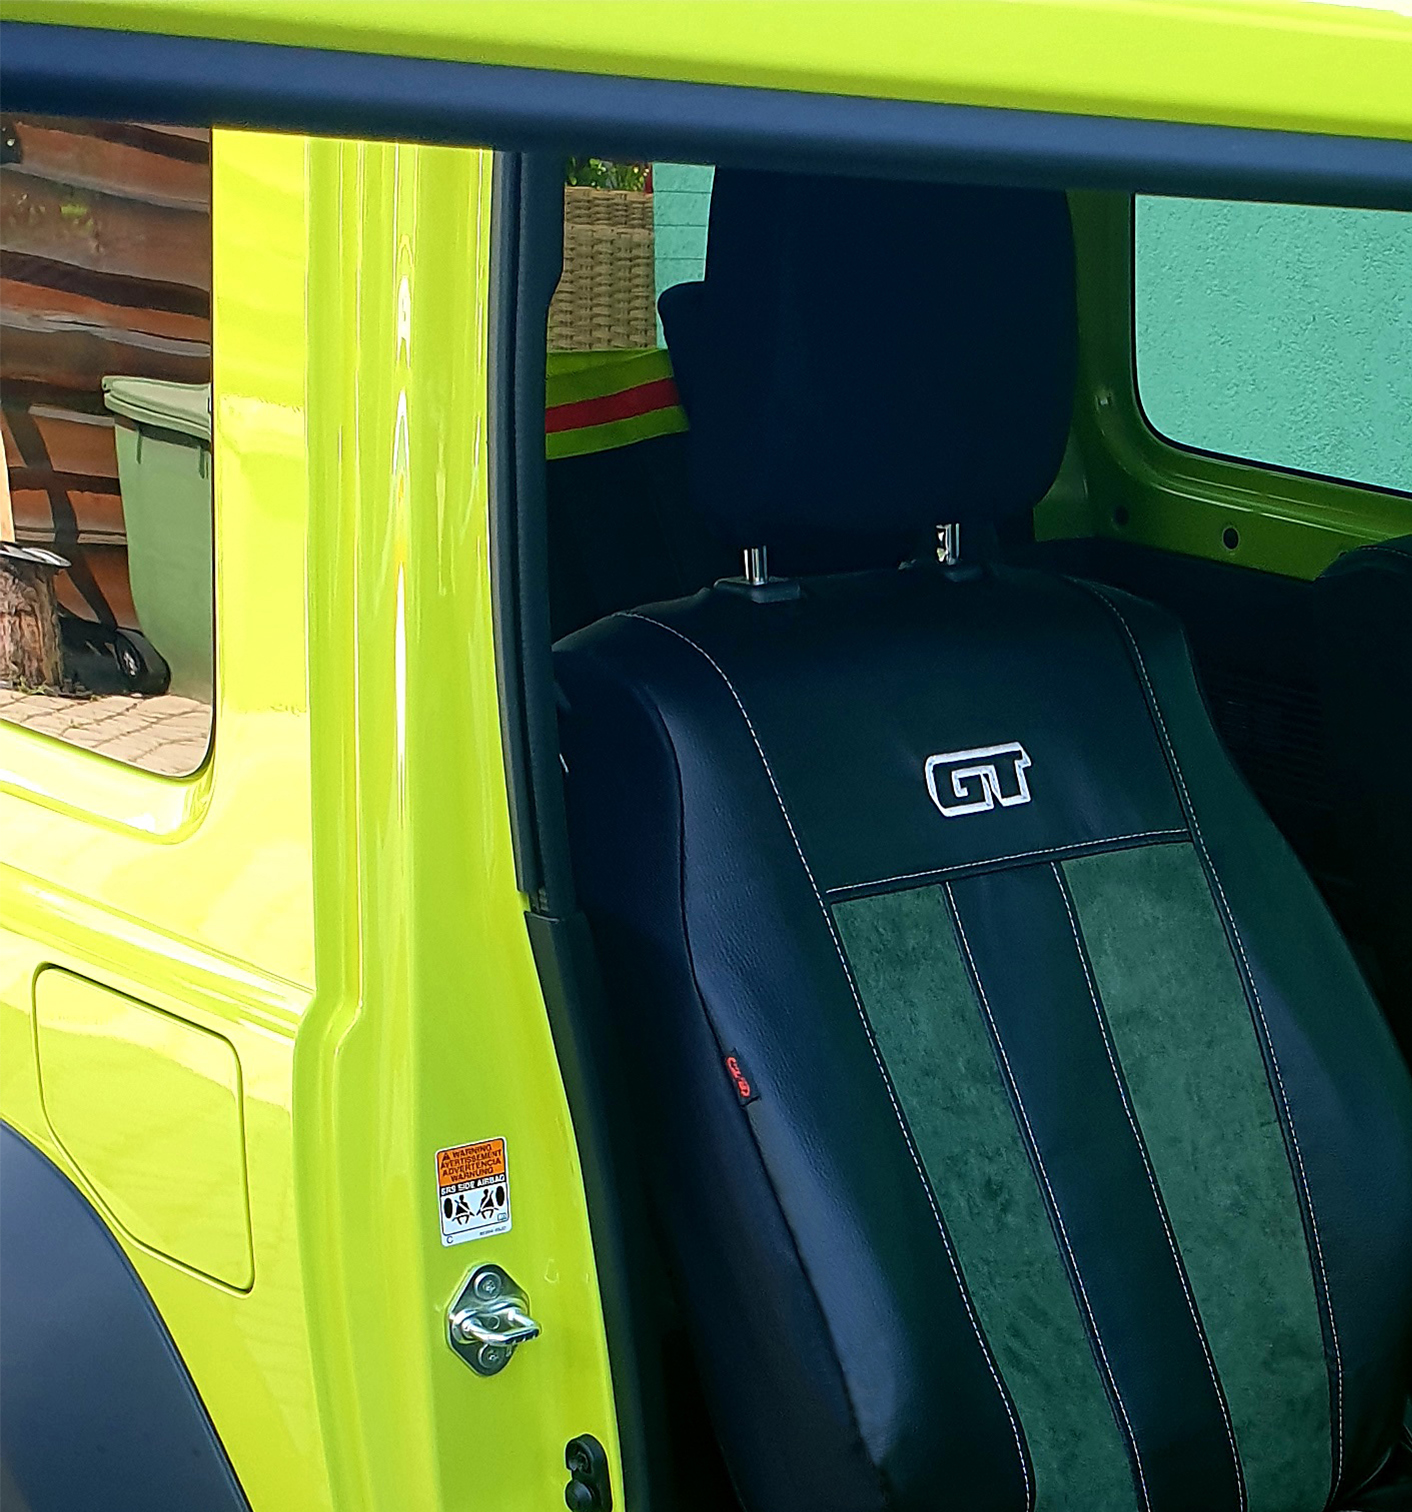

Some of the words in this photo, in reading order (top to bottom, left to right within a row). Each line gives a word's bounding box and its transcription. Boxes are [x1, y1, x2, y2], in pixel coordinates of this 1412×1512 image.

[924, 741, 1032, 817] GT
[453, 1144, 492, 1158] WARNING
[477, 1174, 505, 1186] AIRBAG
